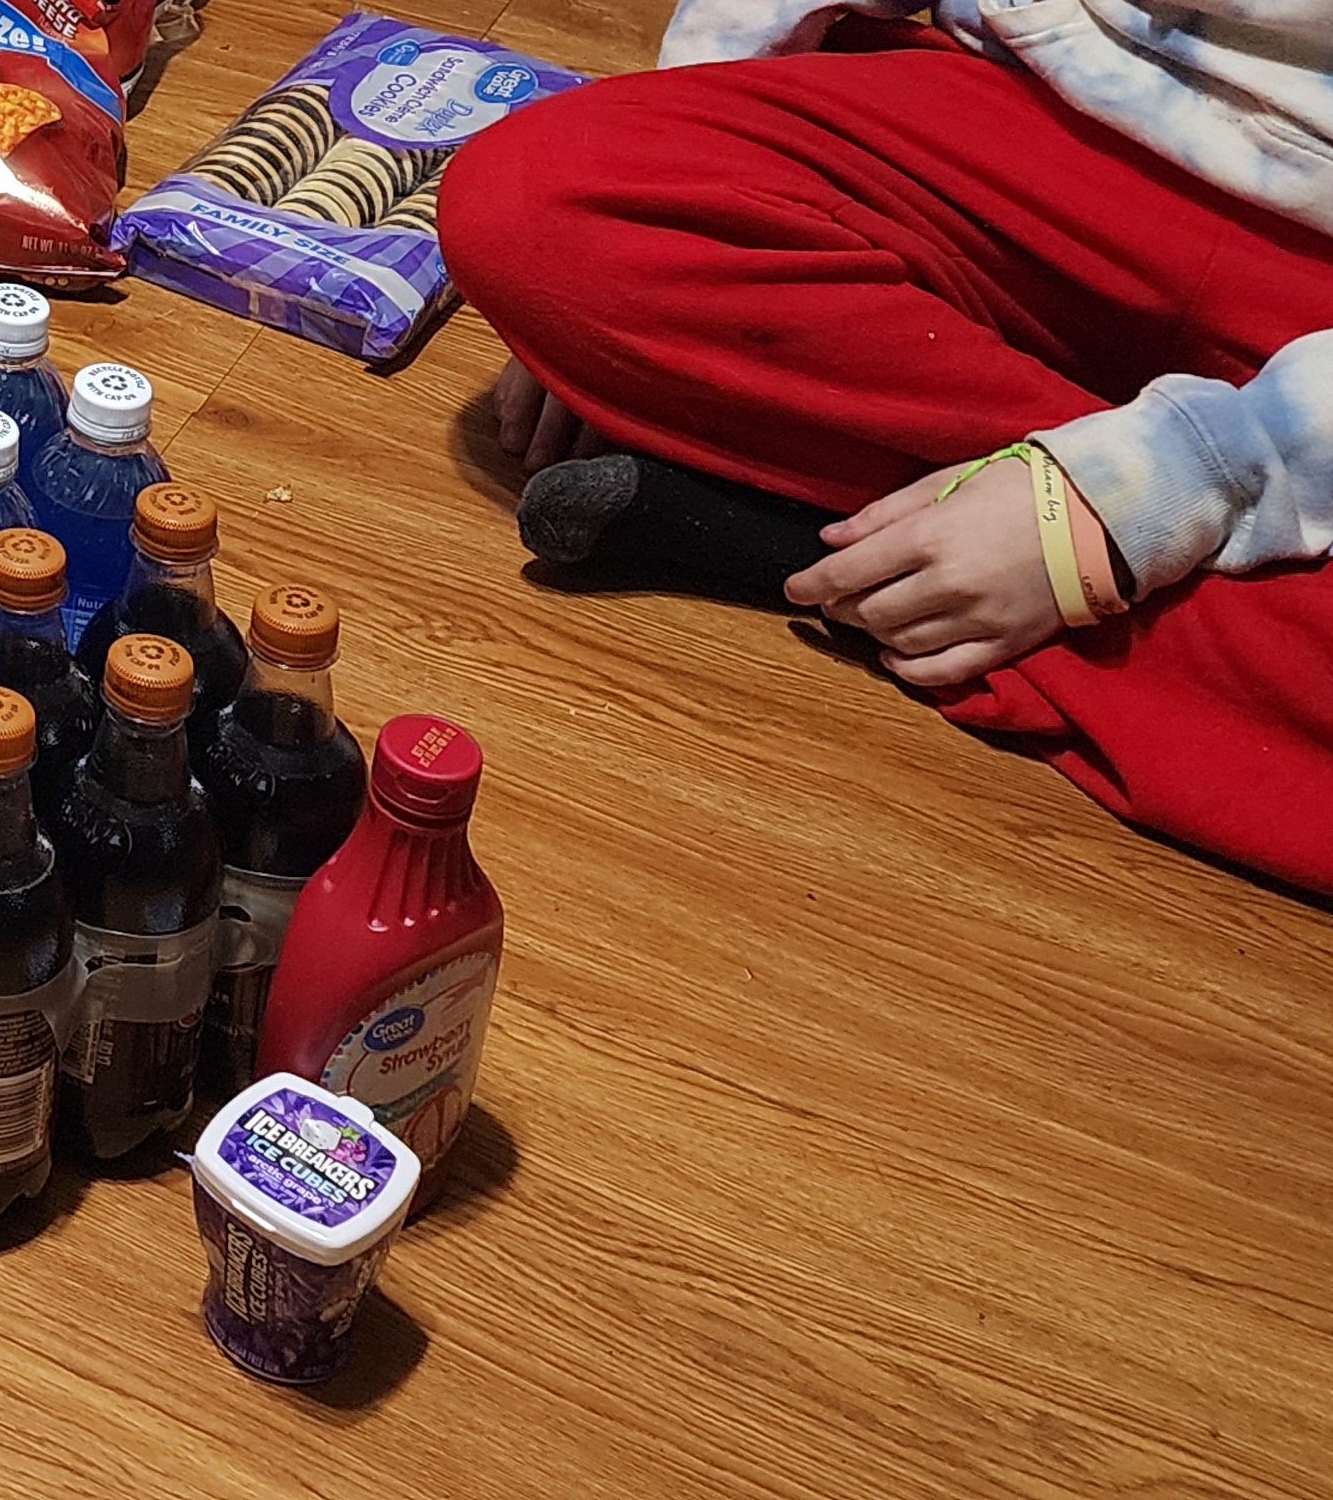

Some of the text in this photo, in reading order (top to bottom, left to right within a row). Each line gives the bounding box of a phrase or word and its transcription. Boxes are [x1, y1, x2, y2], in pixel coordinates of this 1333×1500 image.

[358, 73, 418, 117] Cookies
[415, 56, 465, 101] Sandwich
[484, 71, 510, 95] Value
[501, 69, 531, 99] Great
[416, 99, 475, 137] Duplex
[189, 202, 352, 266] FAMILY SIZE
[372, 1013, 416, 1039] Great
[379, 1013, 474, 1076] Strawberry
[425, 1031, 472, 1073] Syrup
[244, 1109, 376, 1201] ICE BREAKERS
[246, 1134, 348, 1205] ICE CUBES
[247, 1150, 323, 1206] arctic grape
[224, 1221, 254, 1324] ICE BREAKERS
[248, 1249, 269, 1323] ICE CUBES
